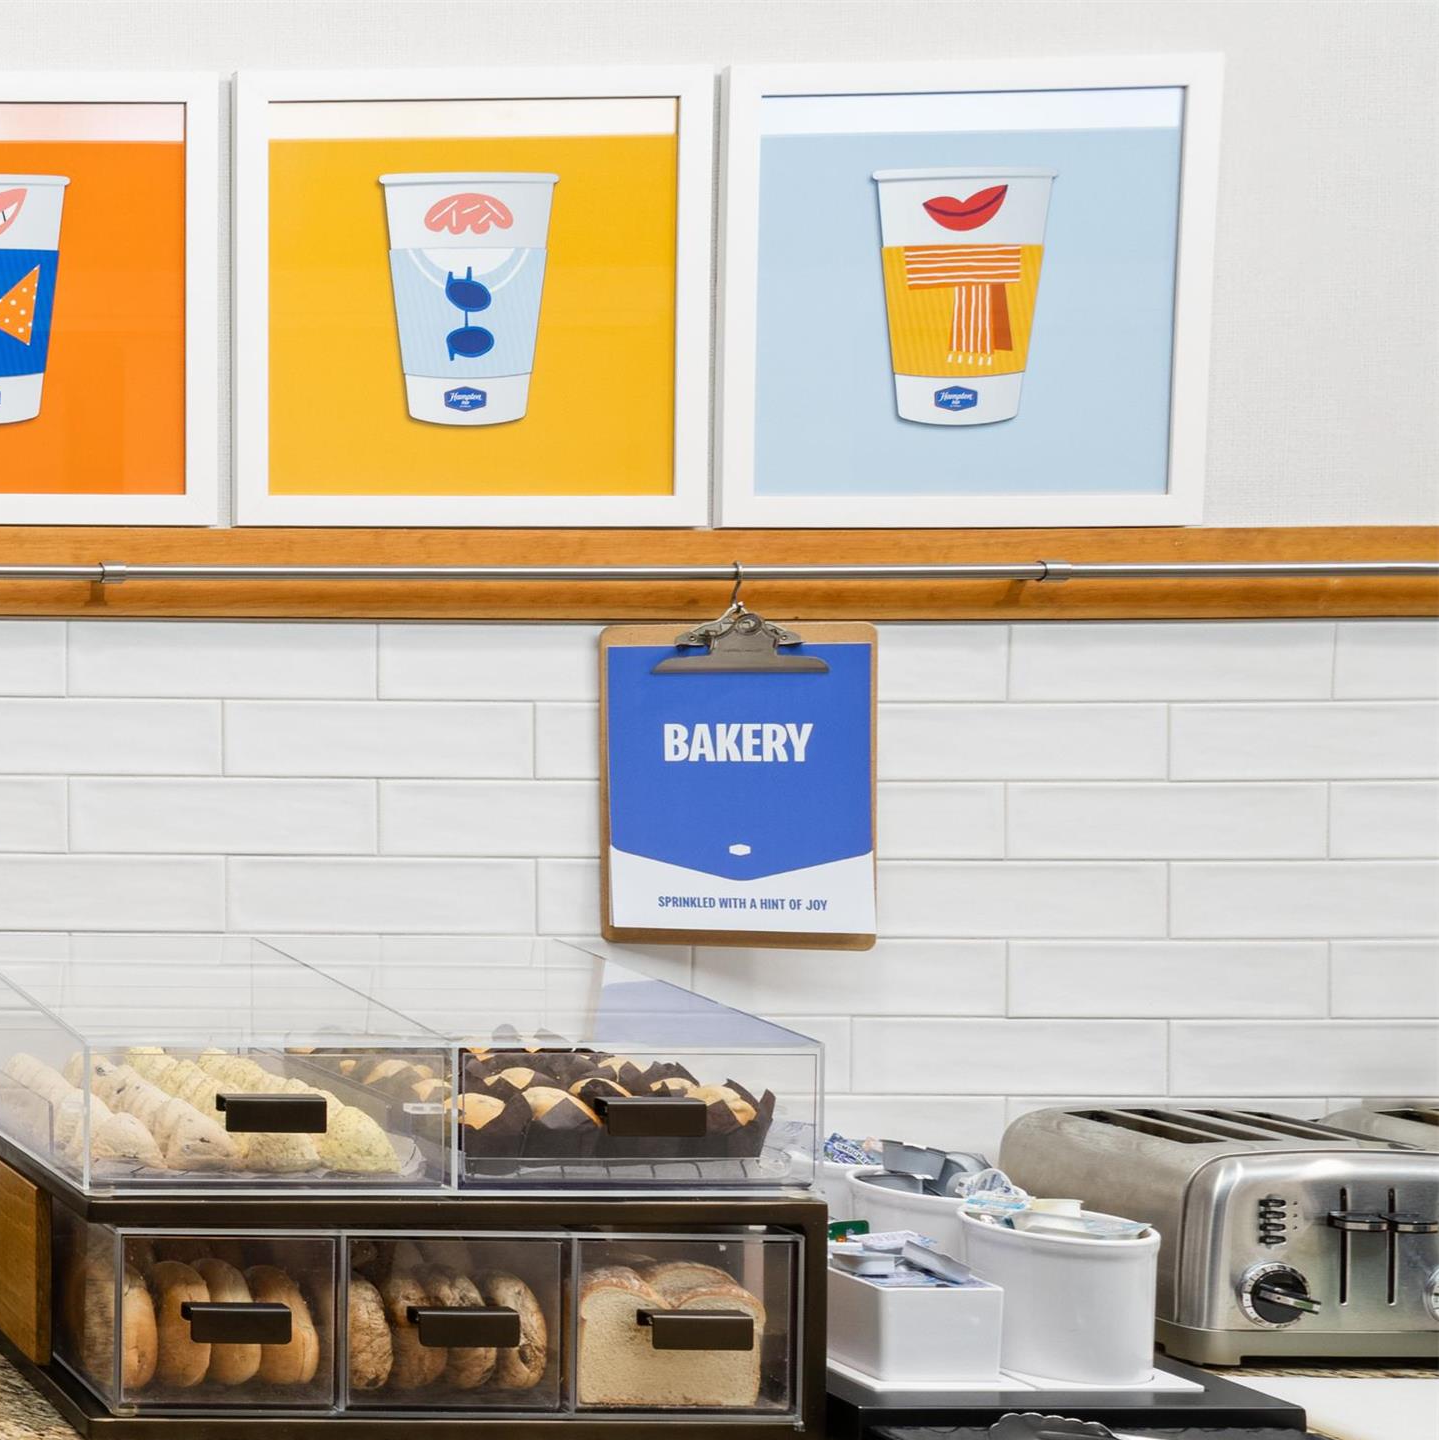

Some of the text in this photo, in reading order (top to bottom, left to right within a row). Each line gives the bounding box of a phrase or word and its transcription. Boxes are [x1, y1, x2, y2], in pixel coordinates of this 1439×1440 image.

[663, 722, 814, 763] BAKERY
[657, 895, 828, 911] SPRINKLED WITH A HINT OF JOY
